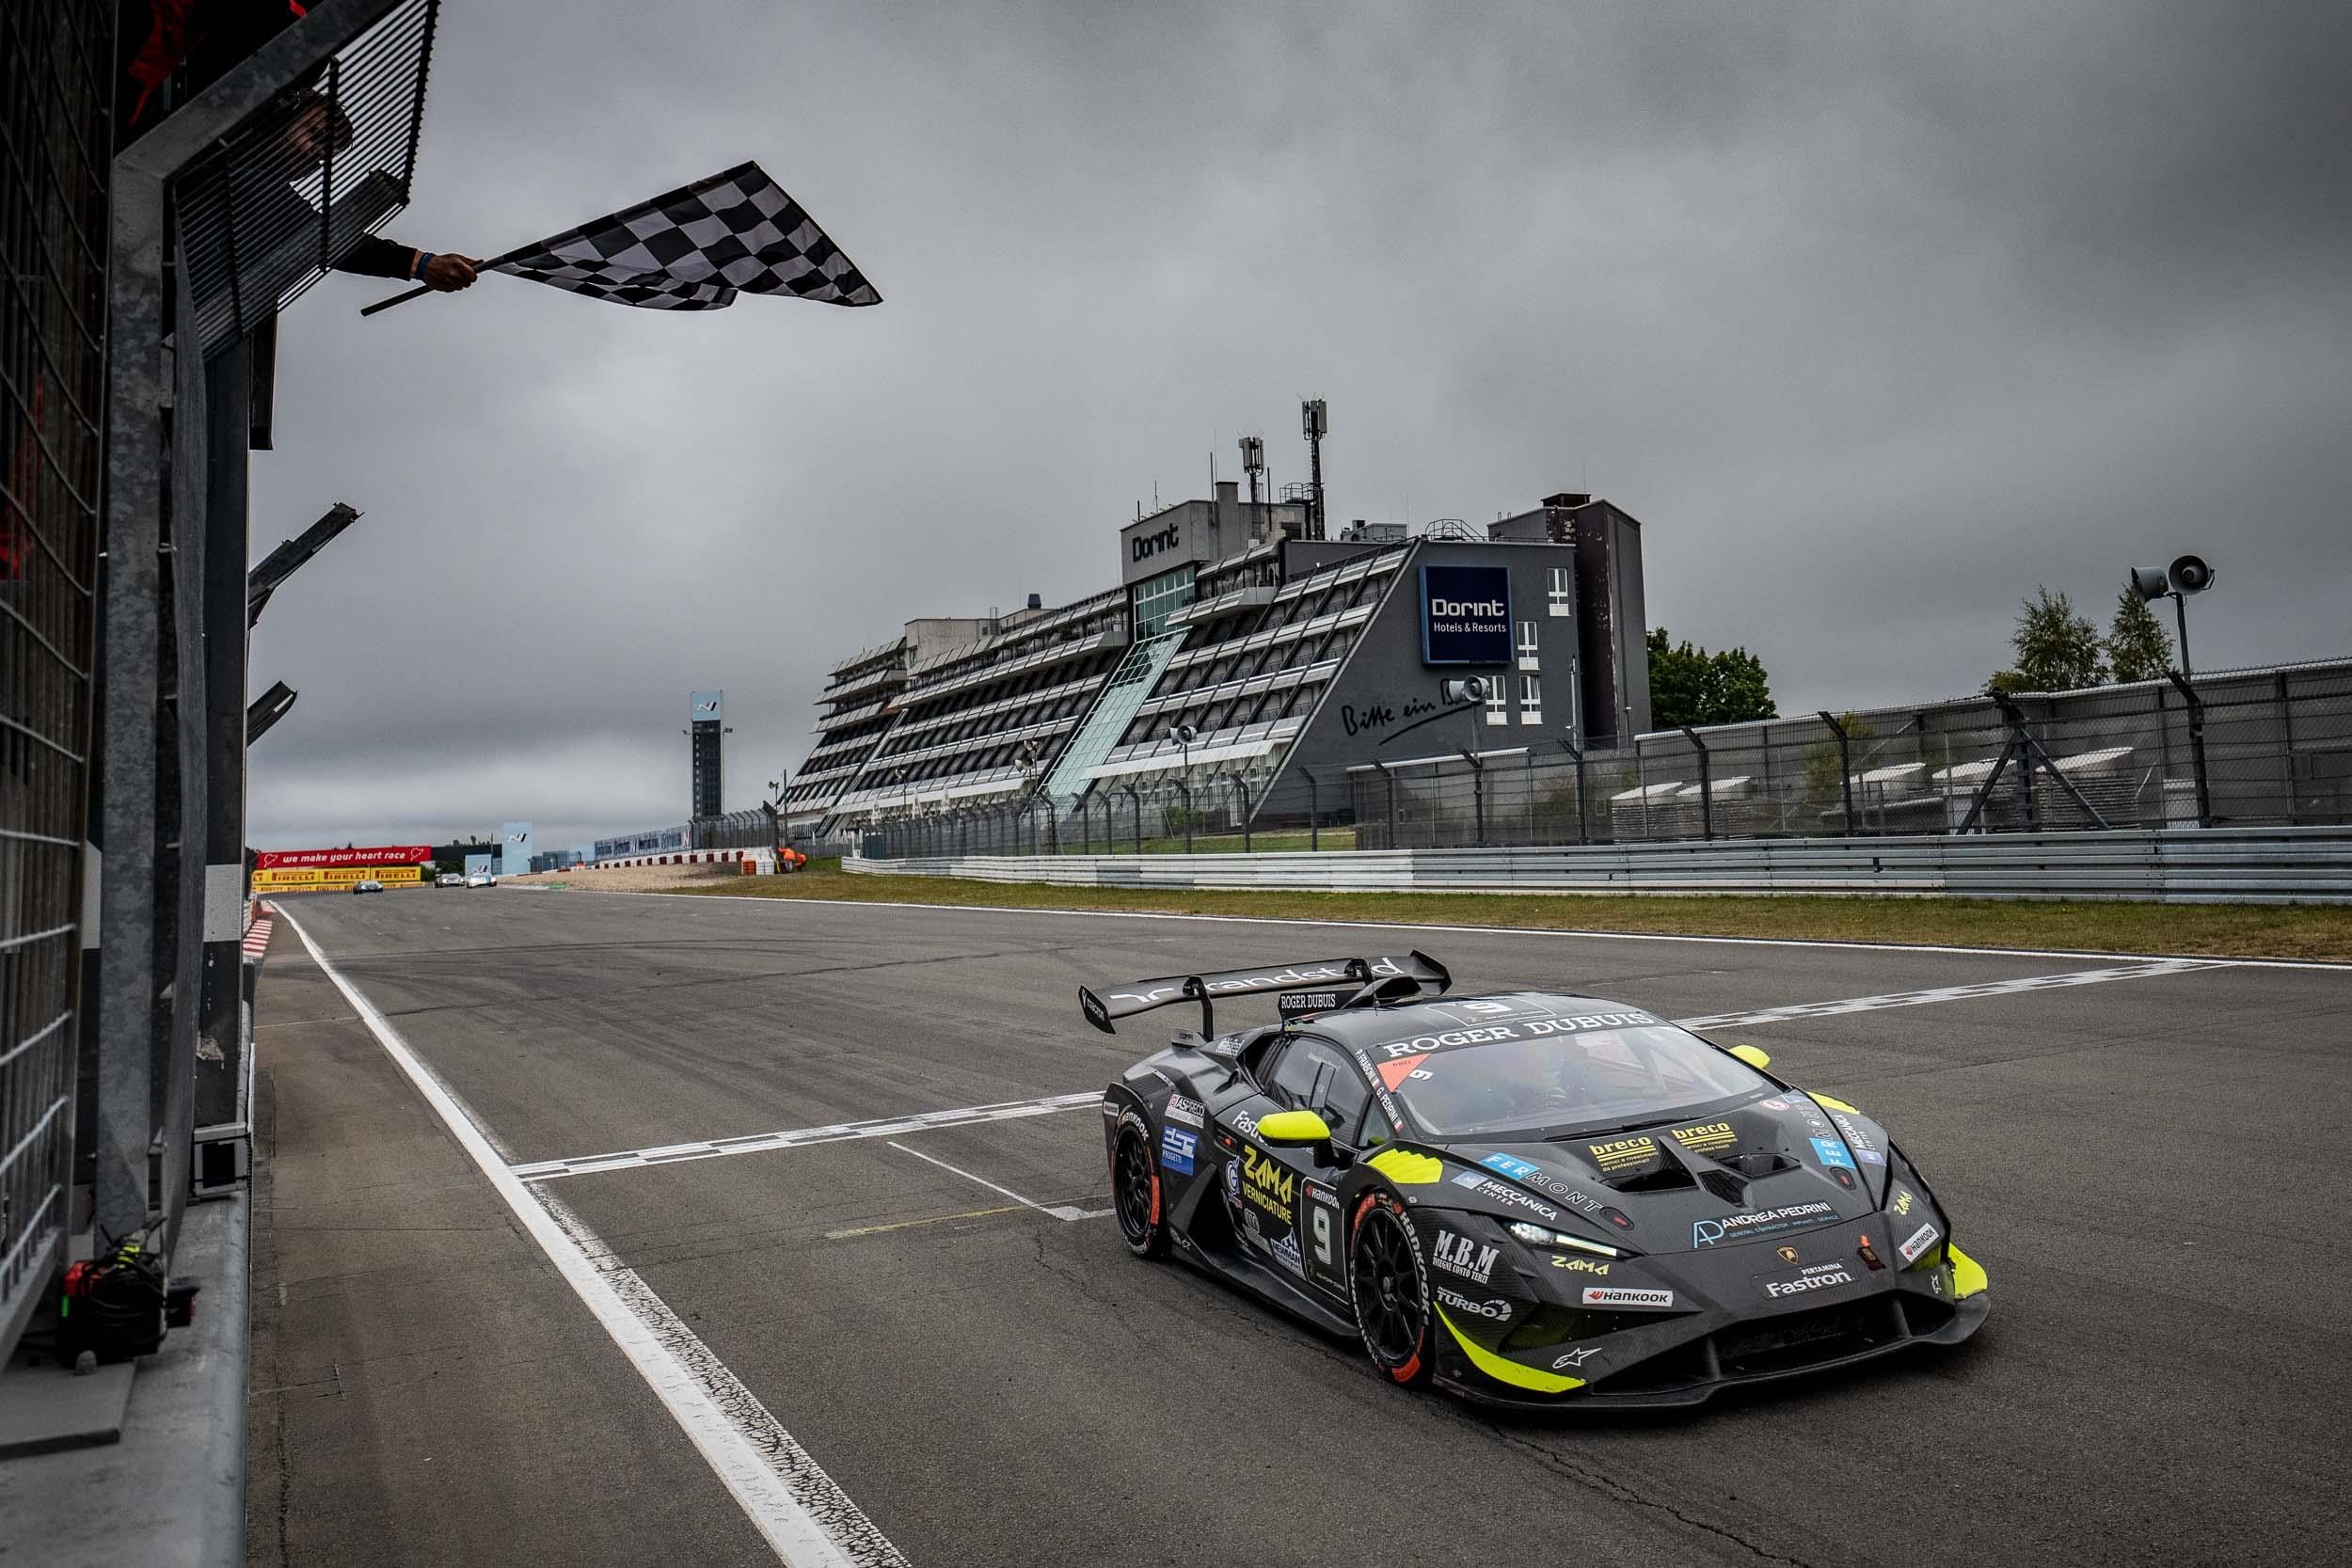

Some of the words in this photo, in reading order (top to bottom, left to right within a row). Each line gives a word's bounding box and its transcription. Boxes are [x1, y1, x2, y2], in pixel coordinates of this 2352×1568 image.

[1132, 522, 1180, 562] Dorint
[1432, 598, 1504, 616] Dorint
[1434, 622, 1463, 632] Hotels
[1465, 623, 1470, 632] &
[1472, 622, 1507, 632] Resorts
[1342, 705, 1395, 736] Bitte
[1404, 698, 1437, 717] ein
[300, 853, 327, 862] make
[330, 852, 353, 863] your
[356, 850, 381, 860] heart
[384, 851, 405, 860] race
[1194, 958, 1405, 996] randstd
[1281, 995, 1306, 1009] ROGER
[1308, 994, 1336, 1008] DUBUIS
[1383, 1026, 1520, 1058] ROGER
[1523, 1012, 1655, 1035] DUBUIS
[1672, 1122, 1731, 1140] breco
[1589, 1136, 1653, 1156] breco
[1242, 1180, 1293, 1226] VERNICIATURE
[1477, 1187, 1514, 1207] CENTER
[1483, 1180, 1559, 1221] MECCANICA
[1721, 1210, 1780, 1228] ANDREA
[1776, 1201, 1833, 1220] PEDRINI
[1313, 1205, 1332, 1265] 9
[1433, 1229, 1501, 1275] M.B.M
[1551, 1255, 1610, 1276] ZAMA
[1432, 1256, 1454, 1273] INSEGNE
[1453, 1262, 1471, 1278] CONTO
[1470, 1270, 1489, 1285] TERZI
[1801, 1262, 1843, 1275] PERTAMINA
[1766, 1271, 1852, 1297] Fastron
[1437, 1290, 1498, 1318] TURBO
